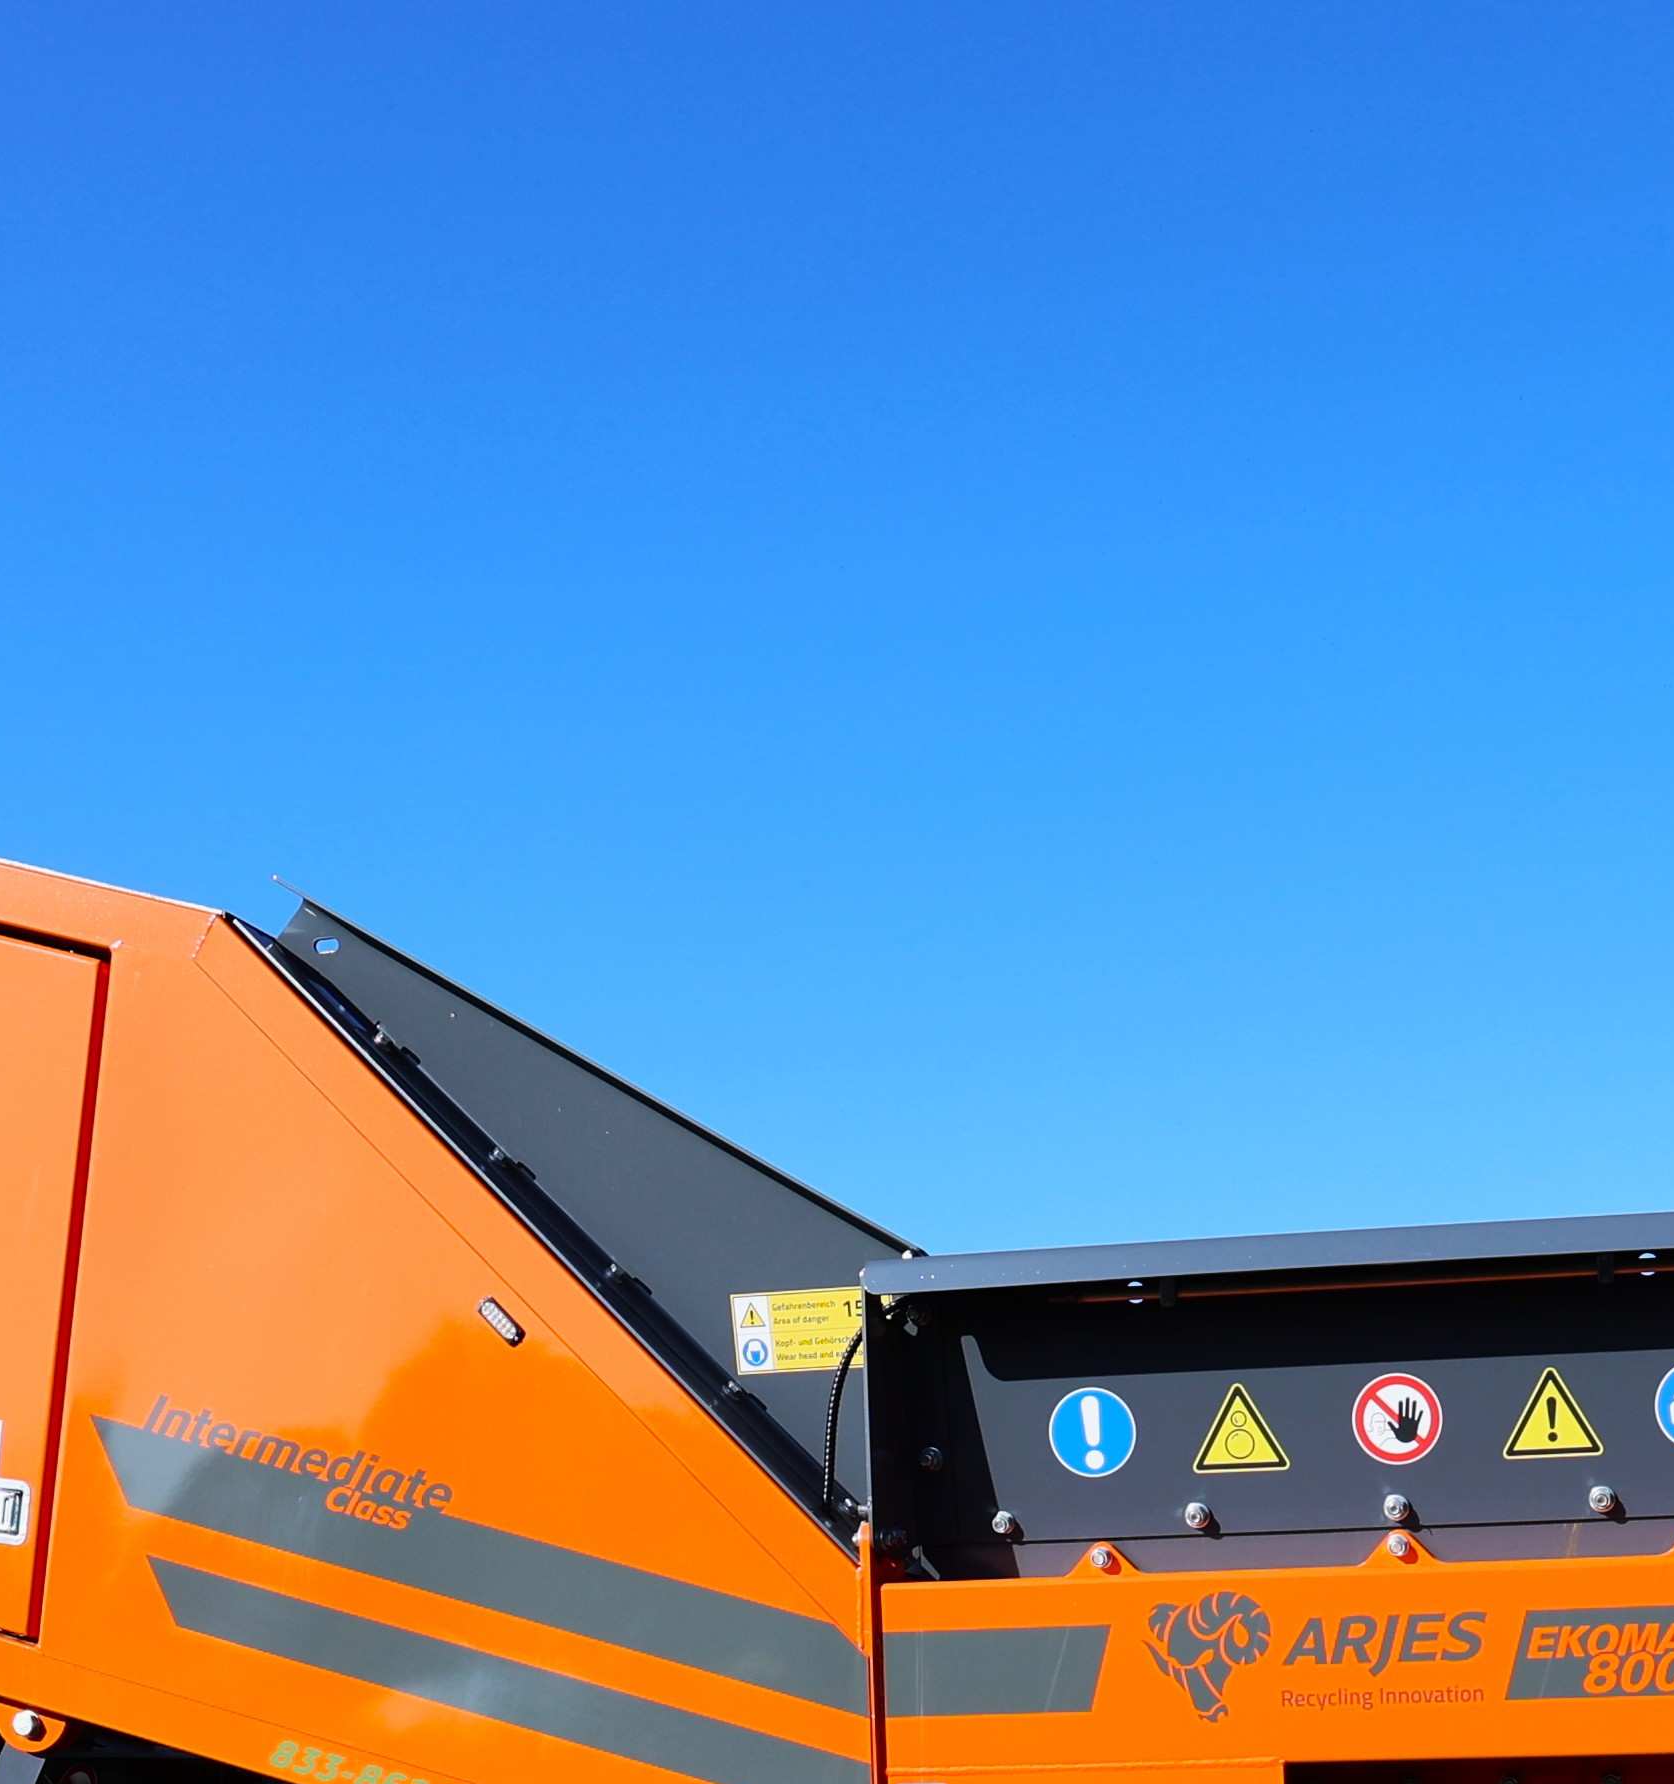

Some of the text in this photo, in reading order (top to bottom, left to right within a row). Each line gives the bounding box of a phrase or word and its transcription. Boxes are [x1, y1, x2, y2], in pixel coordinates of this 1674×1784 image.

[772, 1300, 836, 1311] Gefahrenbereich
[774, 1316, 830, 1325] Area of danger
[776, 1352, 797, 1361] Wear
[799, 1352, 817, 1360] head
[820, 1350, 834, 1358] and
[143, 1394, 454, 1510] Intermediate
[325, 1485, 413, 1529] Class
[1282, 1611, 1488, 1677] ARJES
[1281, 1685, 1485, 1711] Recycling Innovation
